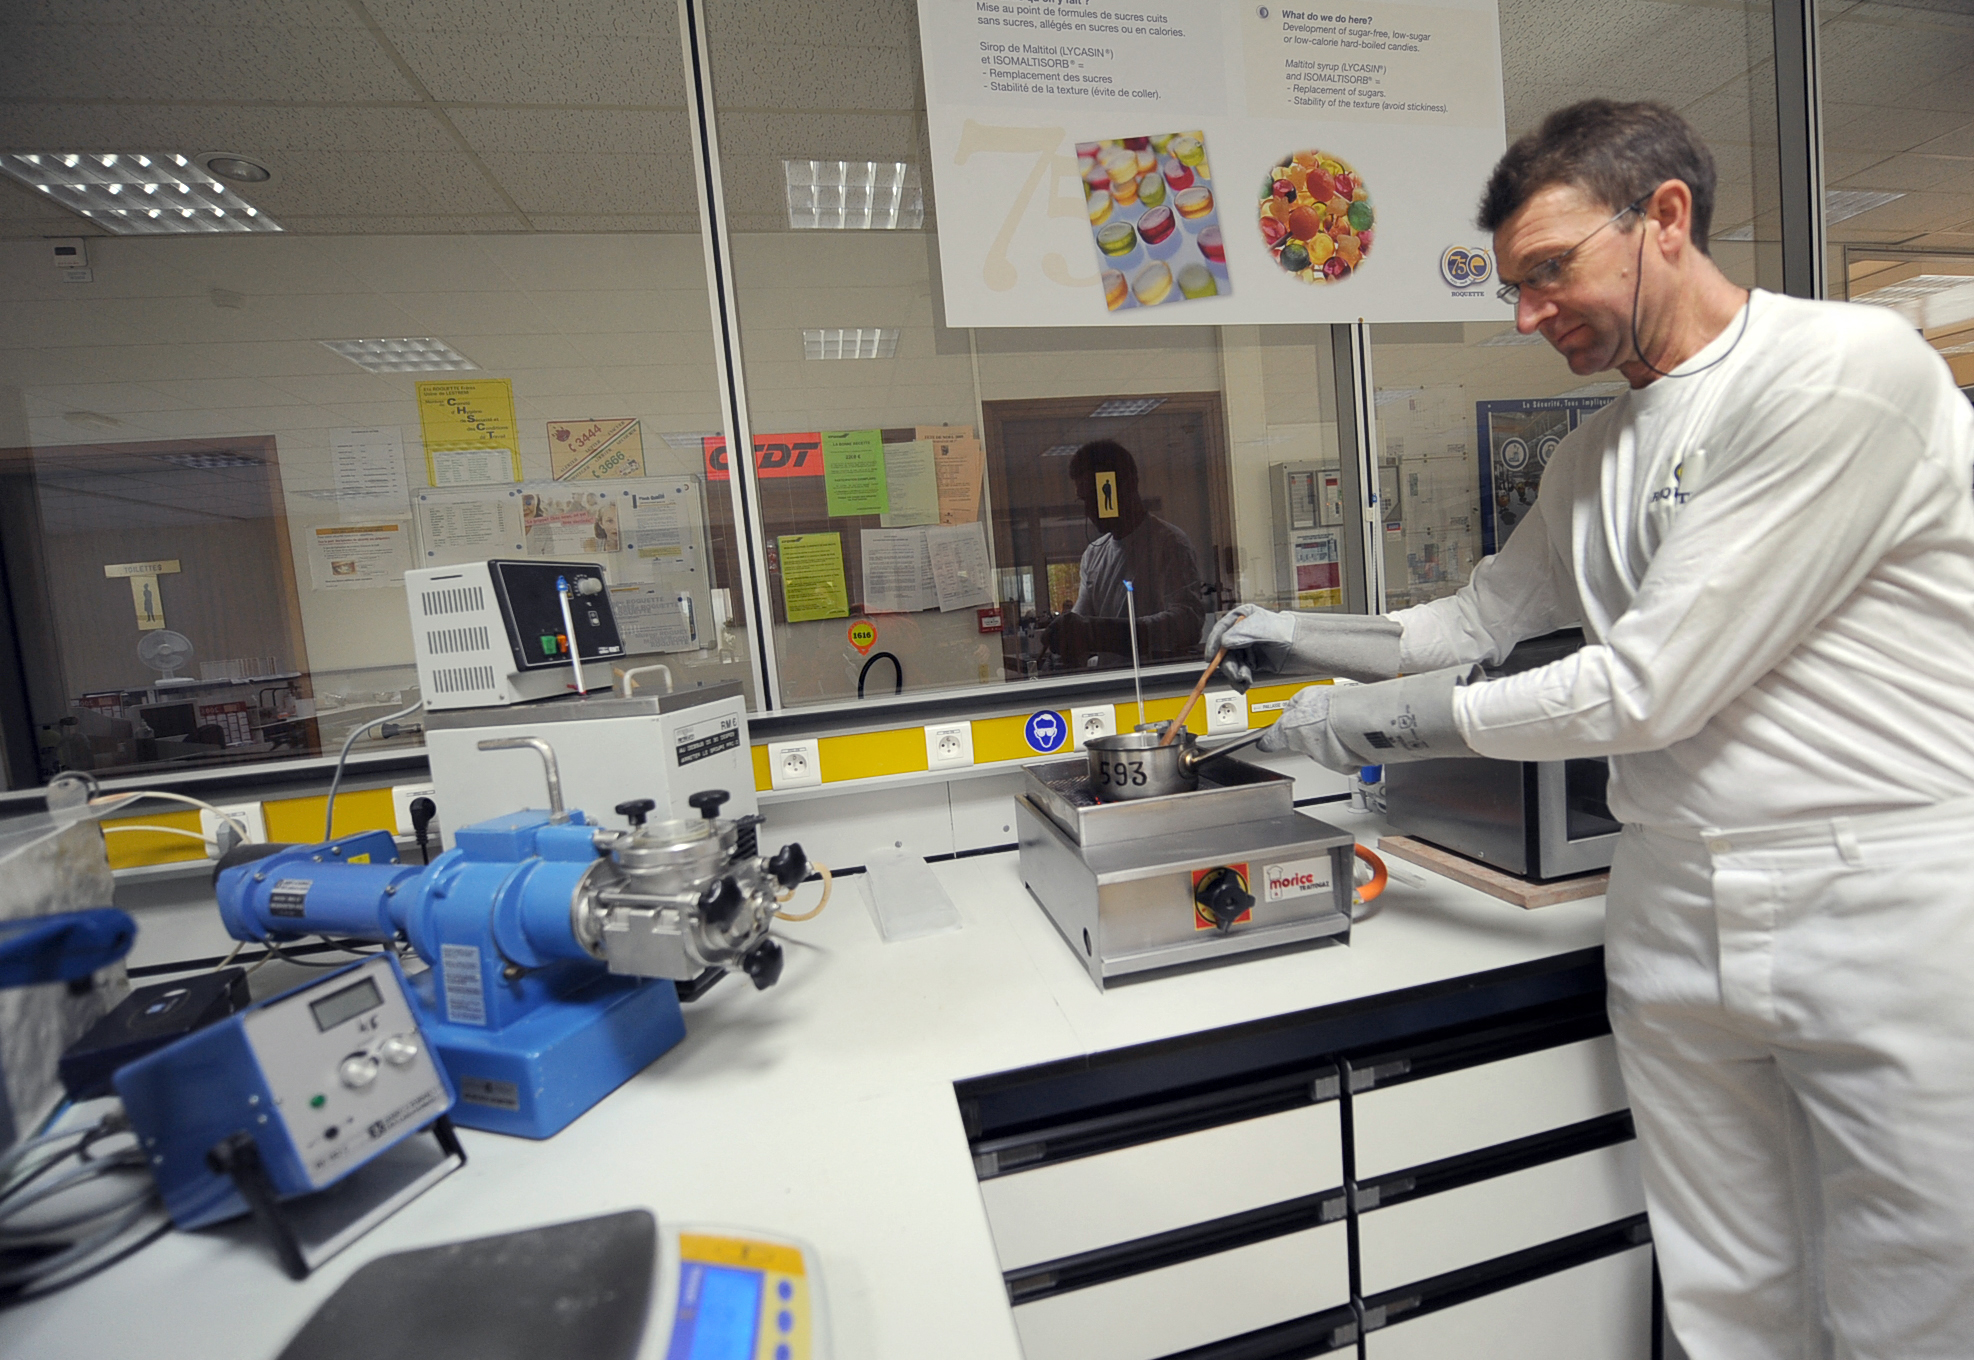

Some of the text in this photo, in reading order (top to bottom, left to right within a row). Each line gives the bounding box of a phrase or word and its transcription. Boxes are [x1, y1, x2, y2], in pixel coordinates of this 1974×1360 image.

[976, 2, 1168, 23] Mise au point de formules de sucres cuits
[1281, 9, 1373, 25] What do we do here?
[977, 16, 1186, 37] sans sucres, allégés en sucres ou en calories.
[1282, 21, 1431, 42] Development of sugar-free, low-sugar
[979, 41, 1006, 54] Sirop
[1007, 43, 1020, 53] de
[1022, 44, 1058, 55] Maltitol
[1283, 35, 1420, 53] or low-calorie hard-boiled candies.
[981, 56, 991, 64] et
[1285, 59, 1316, 69] Maltitol
[1316, 63, 1340, 72] syrup
[989, 68, 1061, 81] Remplacement
[1062, 72, 1080, 82] des
[1082, 75, 1113, 84] sucres
[1285, 73, 1302, 81] and
[990, 81, 1029, 93] Stabilité
[1031, 84, 1044, 93] de
[1046, 84, 1055, 94] la
[1056, 85, 1089, 95] texture
[1091, 86, 1116, 97] (évite
[1117, 87, 1130, 97] de
[1131, 89, 1162, 100] coller).
[1292, 84, 1346, 95] Replacement
[1347, 88, 1357, 96] of
[1357, 89, 1386, 99] sugars.
[1293, 96, 1326, 109] Stability
[1327, 98, 1336, 107] of
[1338, 99, 1351, 108] the
[1353, 100, 1380, 109] texture
[1381, 101, 1406, 111] (avoid
[1407, 102, 1449, 114] stickiness).
[1450, 255, 1467, 275] 75
[575, 424, 602, 447] 3444
[599, 451, 625, 474] 3666
[124, 564, 163, 573] TOILETTES
[1100, 761, 1148, 787] 593
[1269, 872, 1314, 891] morice
